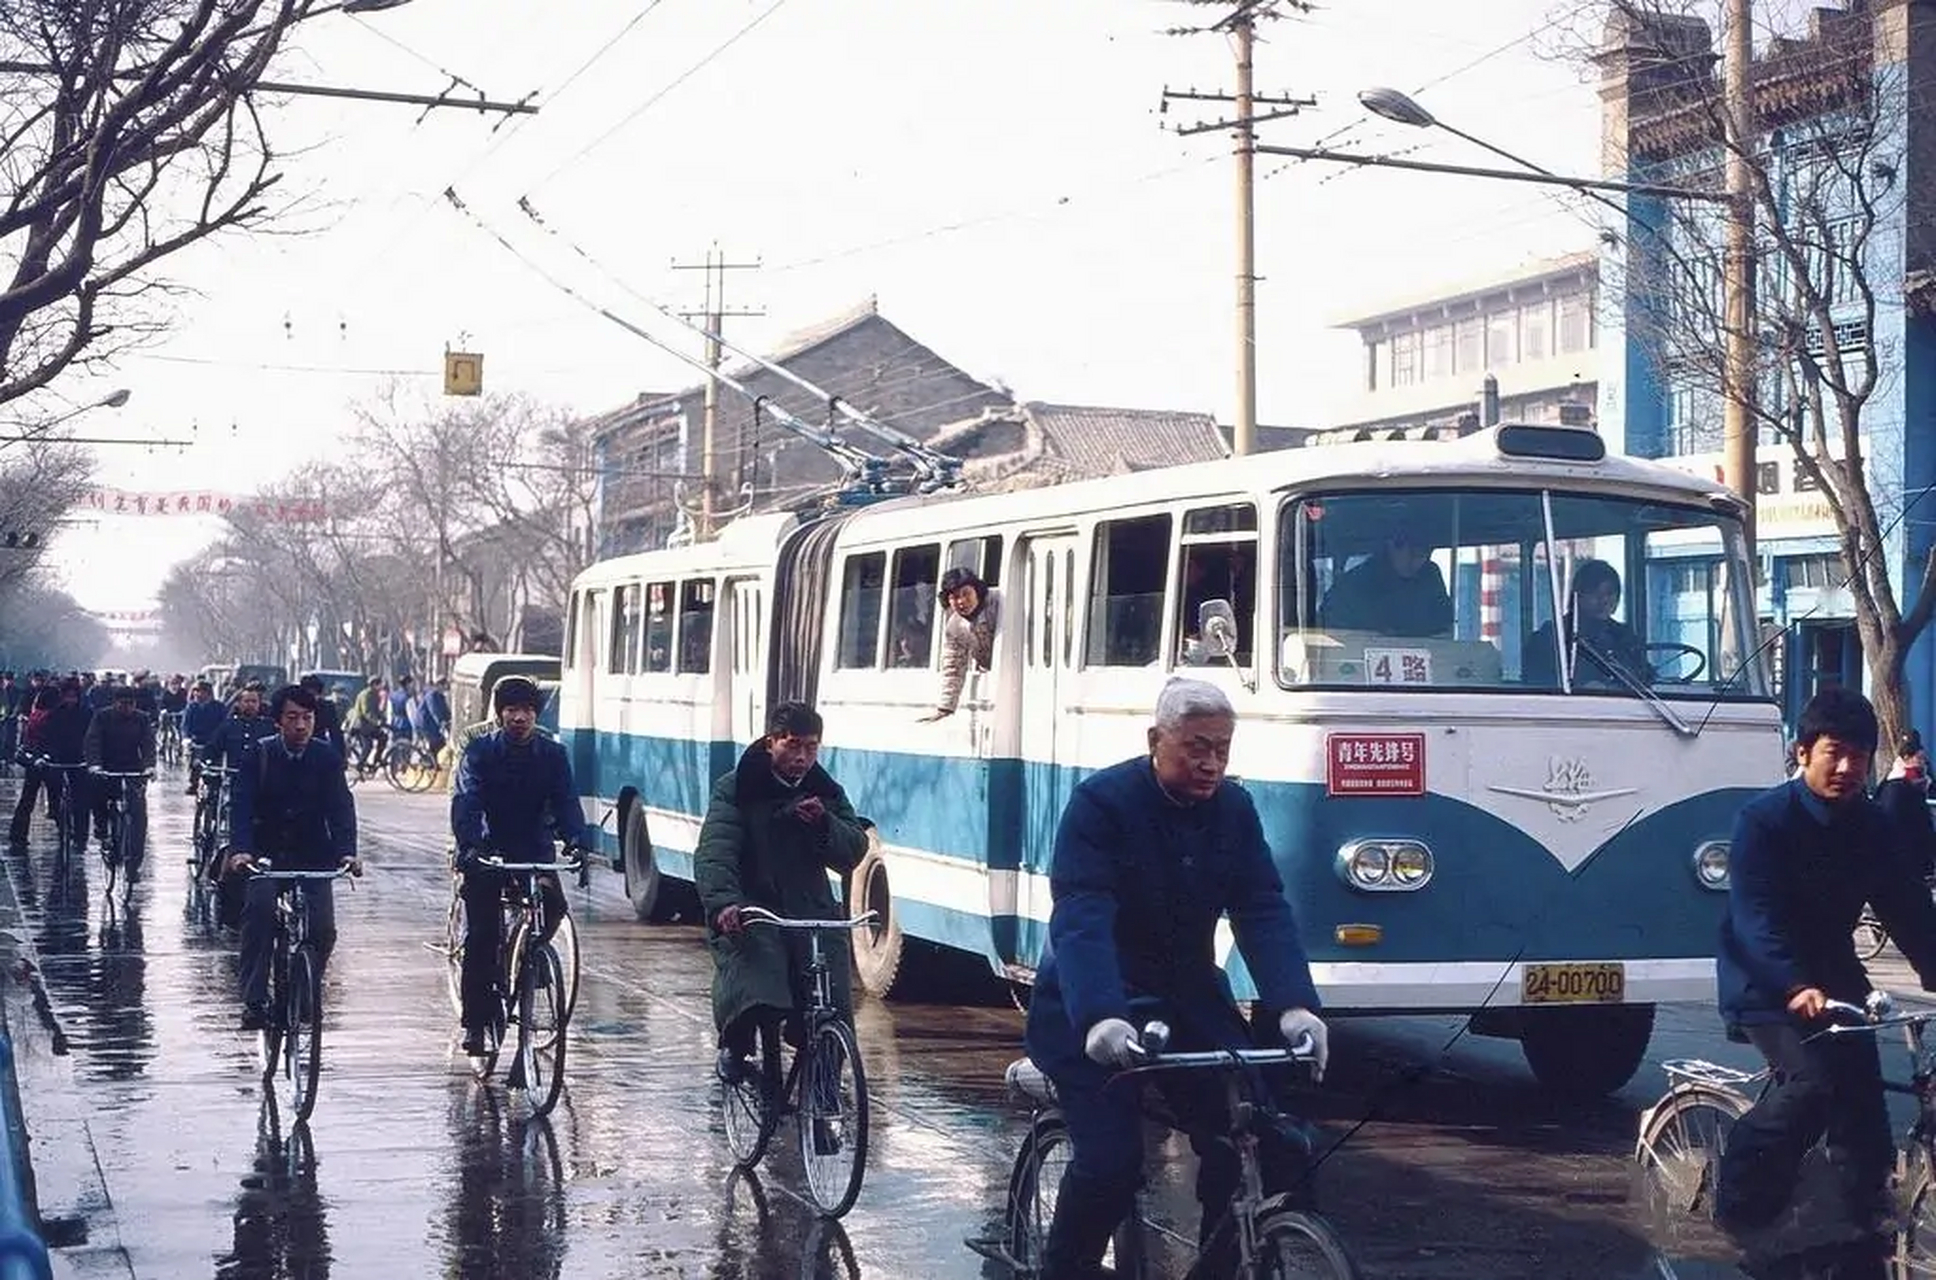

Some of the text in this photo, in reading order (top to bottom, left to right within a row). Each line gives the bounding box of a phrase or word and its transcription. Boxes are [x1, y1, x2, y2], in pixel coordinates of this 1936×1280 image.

[1338, 741, 1414, 763] 青年先锋号
[1526, 971, 1621, 995] 24-00700
